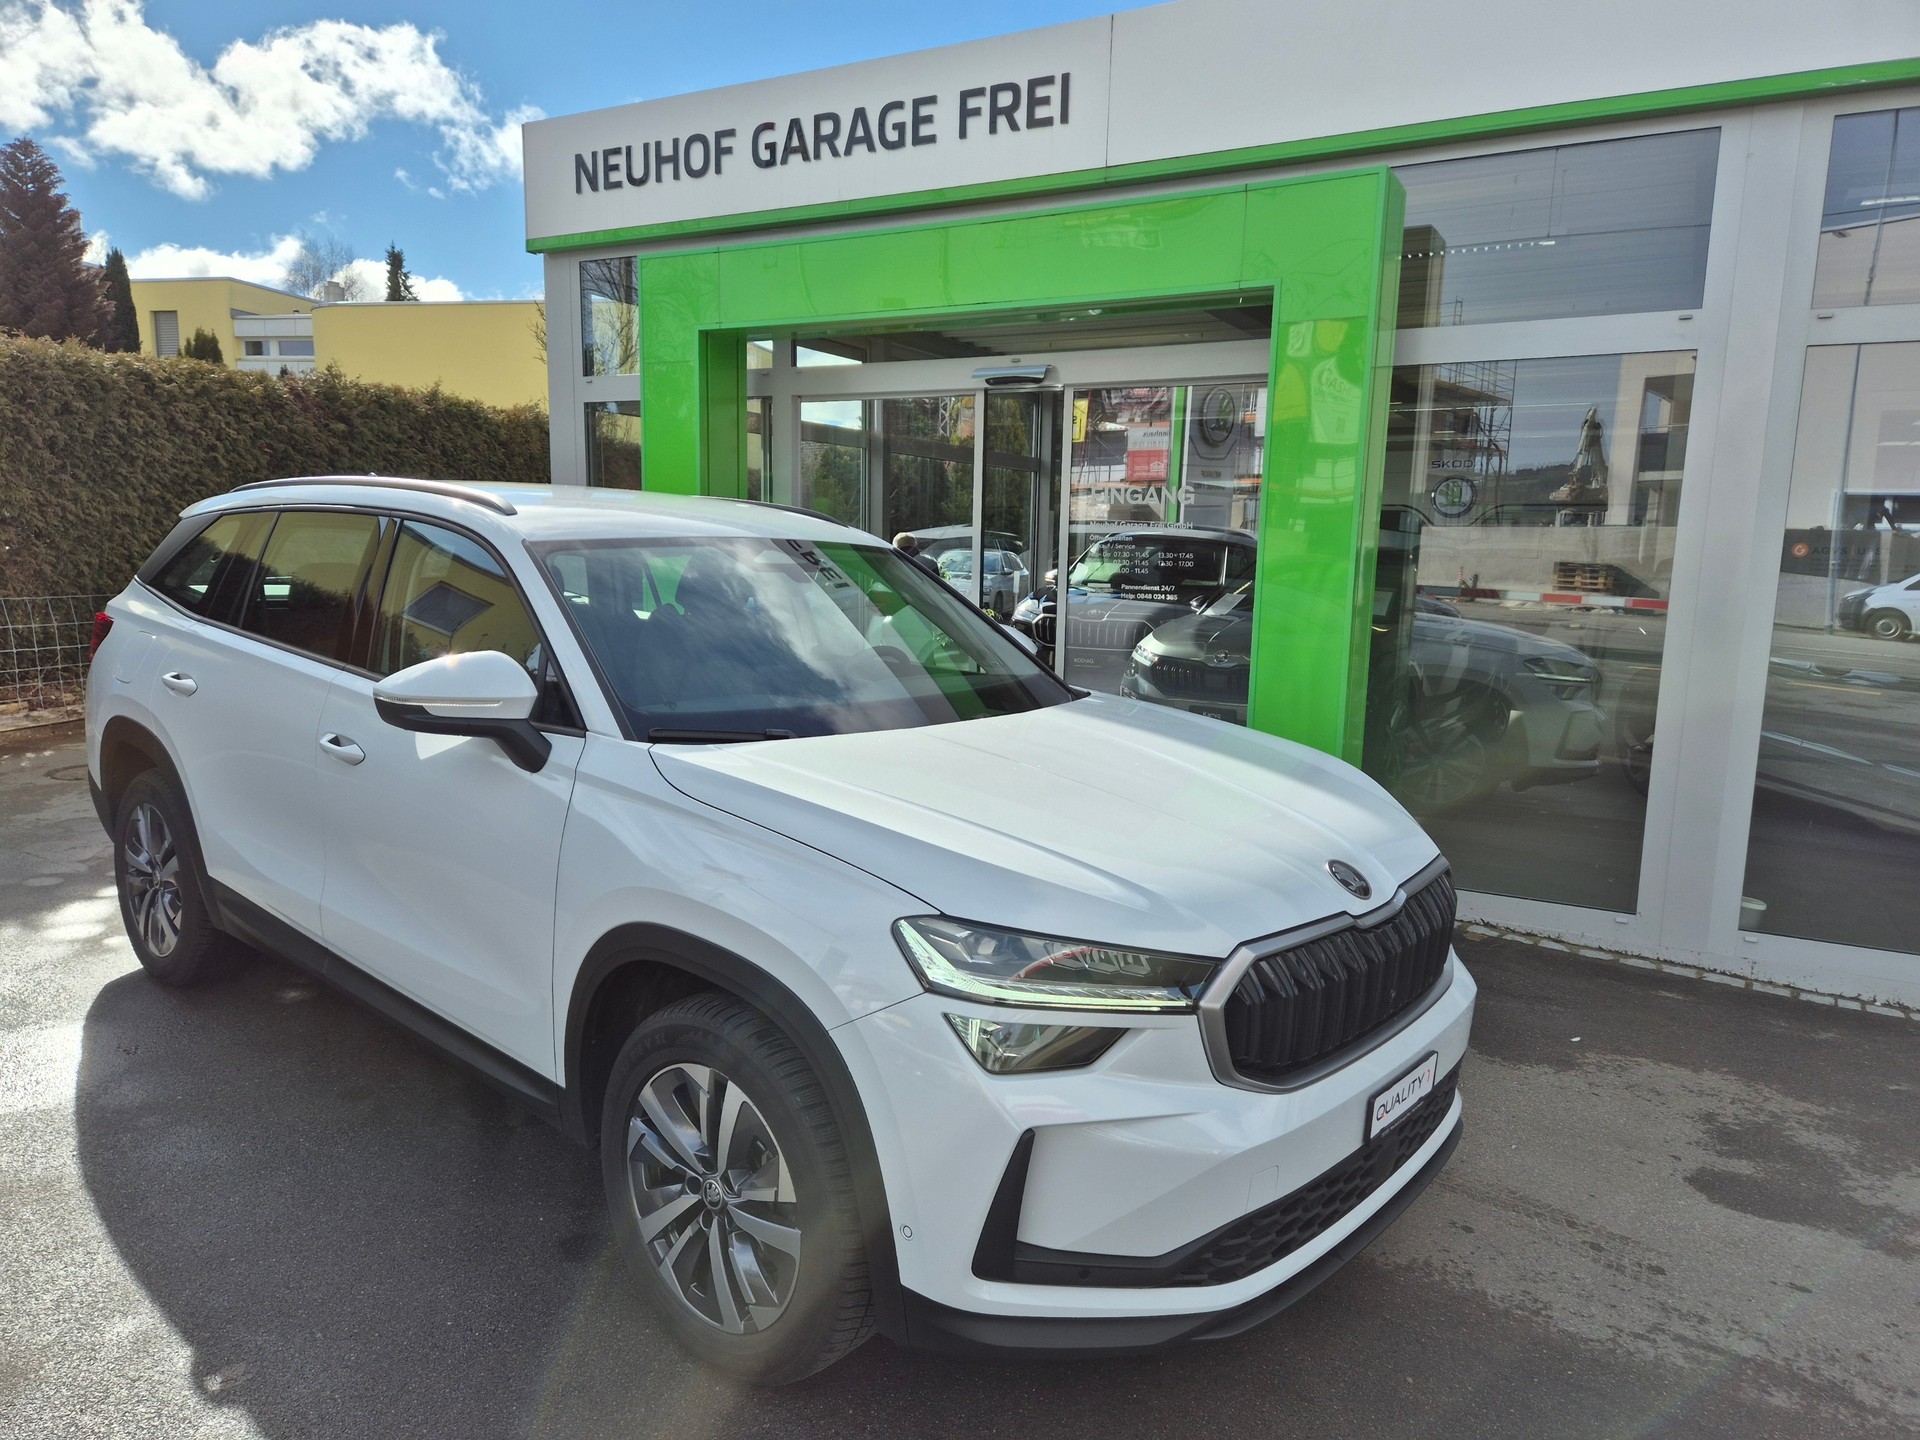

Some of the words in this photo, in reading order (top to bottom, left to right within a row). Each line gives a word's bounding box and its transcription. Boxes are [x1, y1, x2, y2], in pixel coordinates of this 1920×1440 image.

[574, 128, 736, 194] NEUHOF
[751, 95, 937, 169] GARAGE
[958, 72, 1070, 140] FREI
[1432, 460, 1478, 469] SKOD
[1091, 485, 1195, 505] EINGANG
[1120, 521, 1148, 530] Garage
[1090, 534, 1133, 542] Öffngszeiten
[1376, 1072, 1425, 1121] QUALITY
